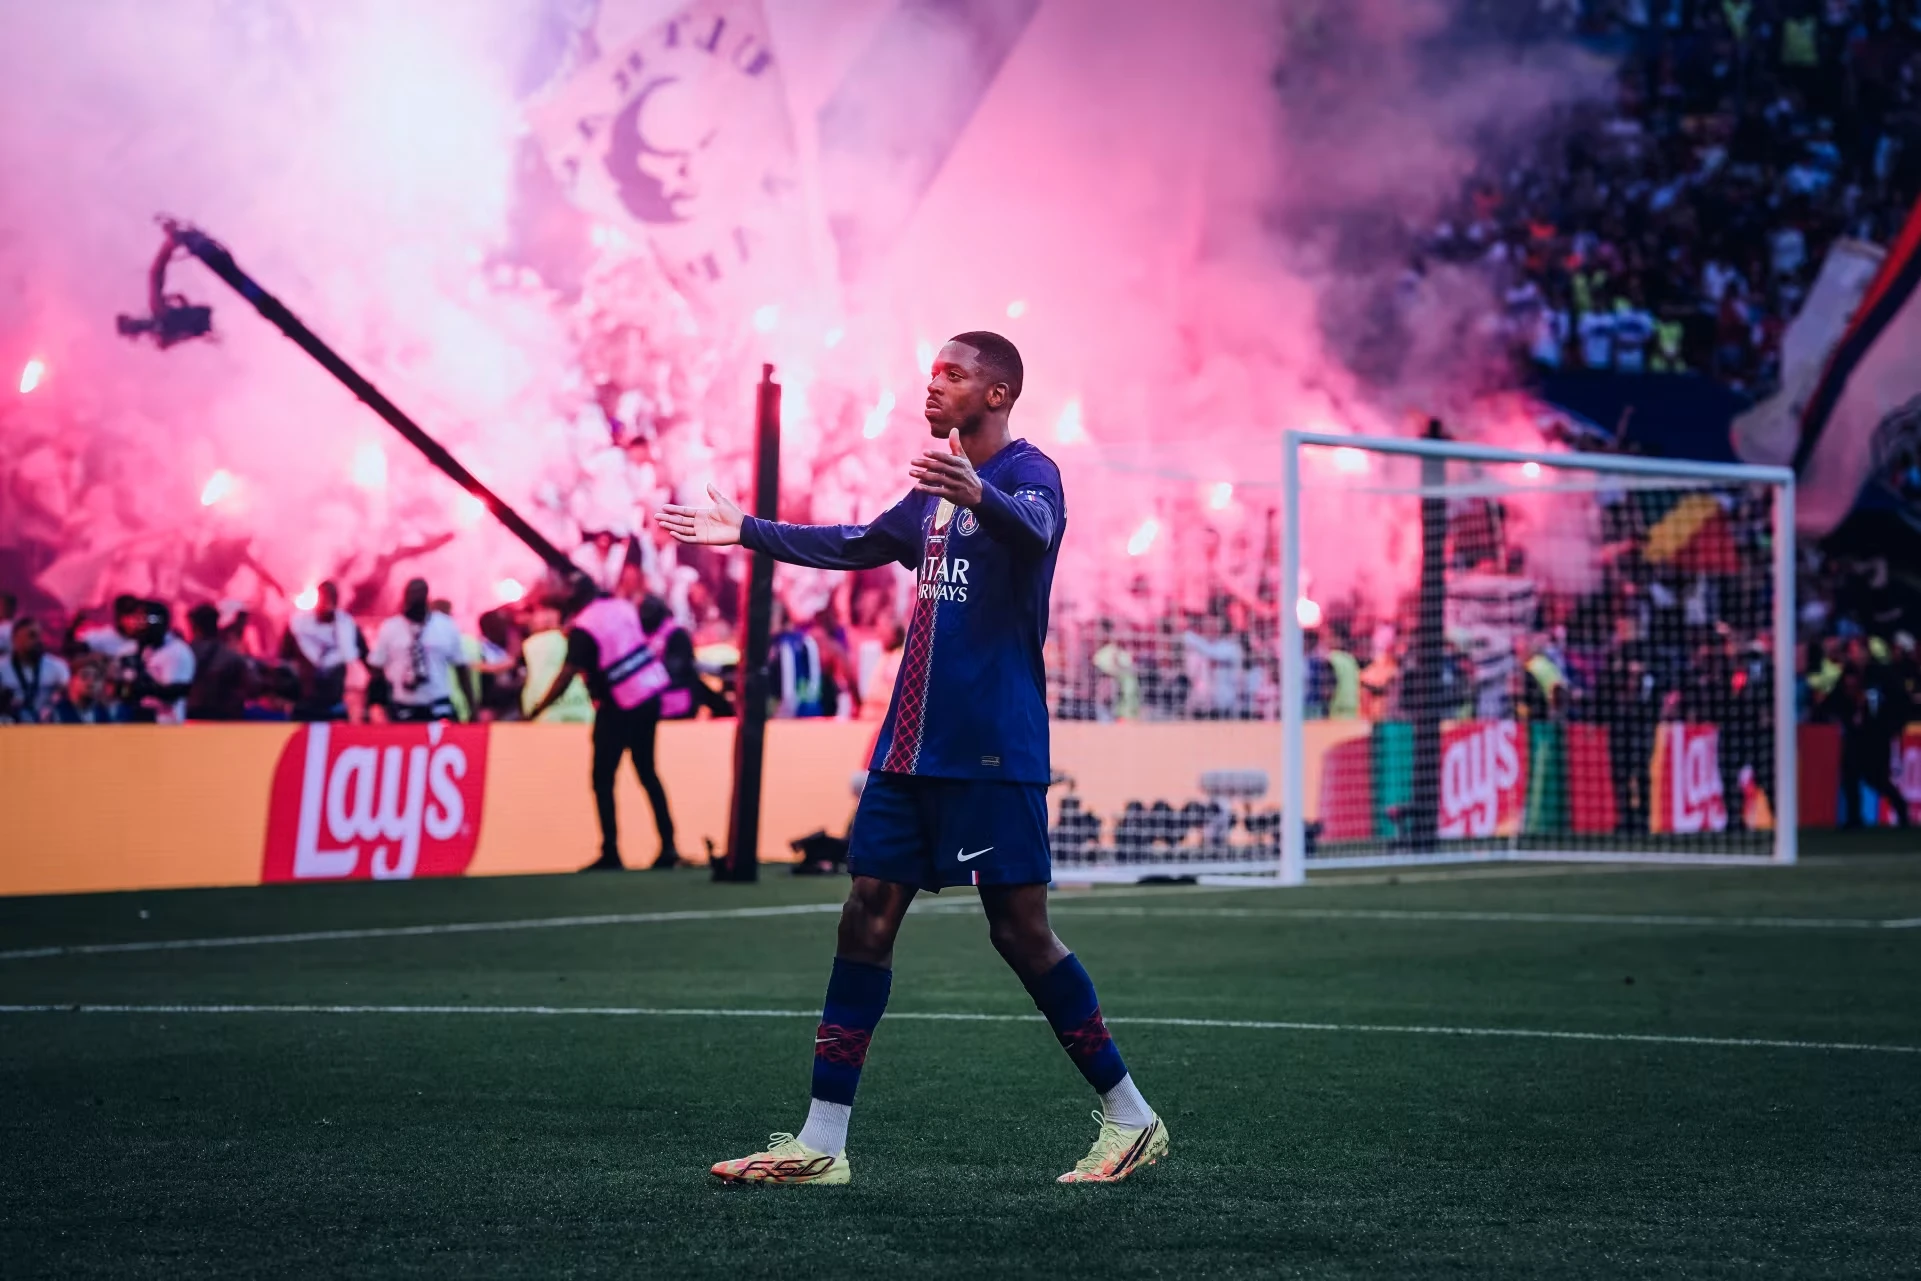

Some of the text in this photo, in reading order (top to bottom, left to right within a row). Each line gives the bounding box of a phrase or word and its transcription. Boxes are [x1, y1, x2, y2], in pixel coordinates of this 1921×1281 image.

[922, 556, 970, 585] TAR
[919, 583, 968, 603] RWAYS
[293, 722, 467, 880] Lay's
